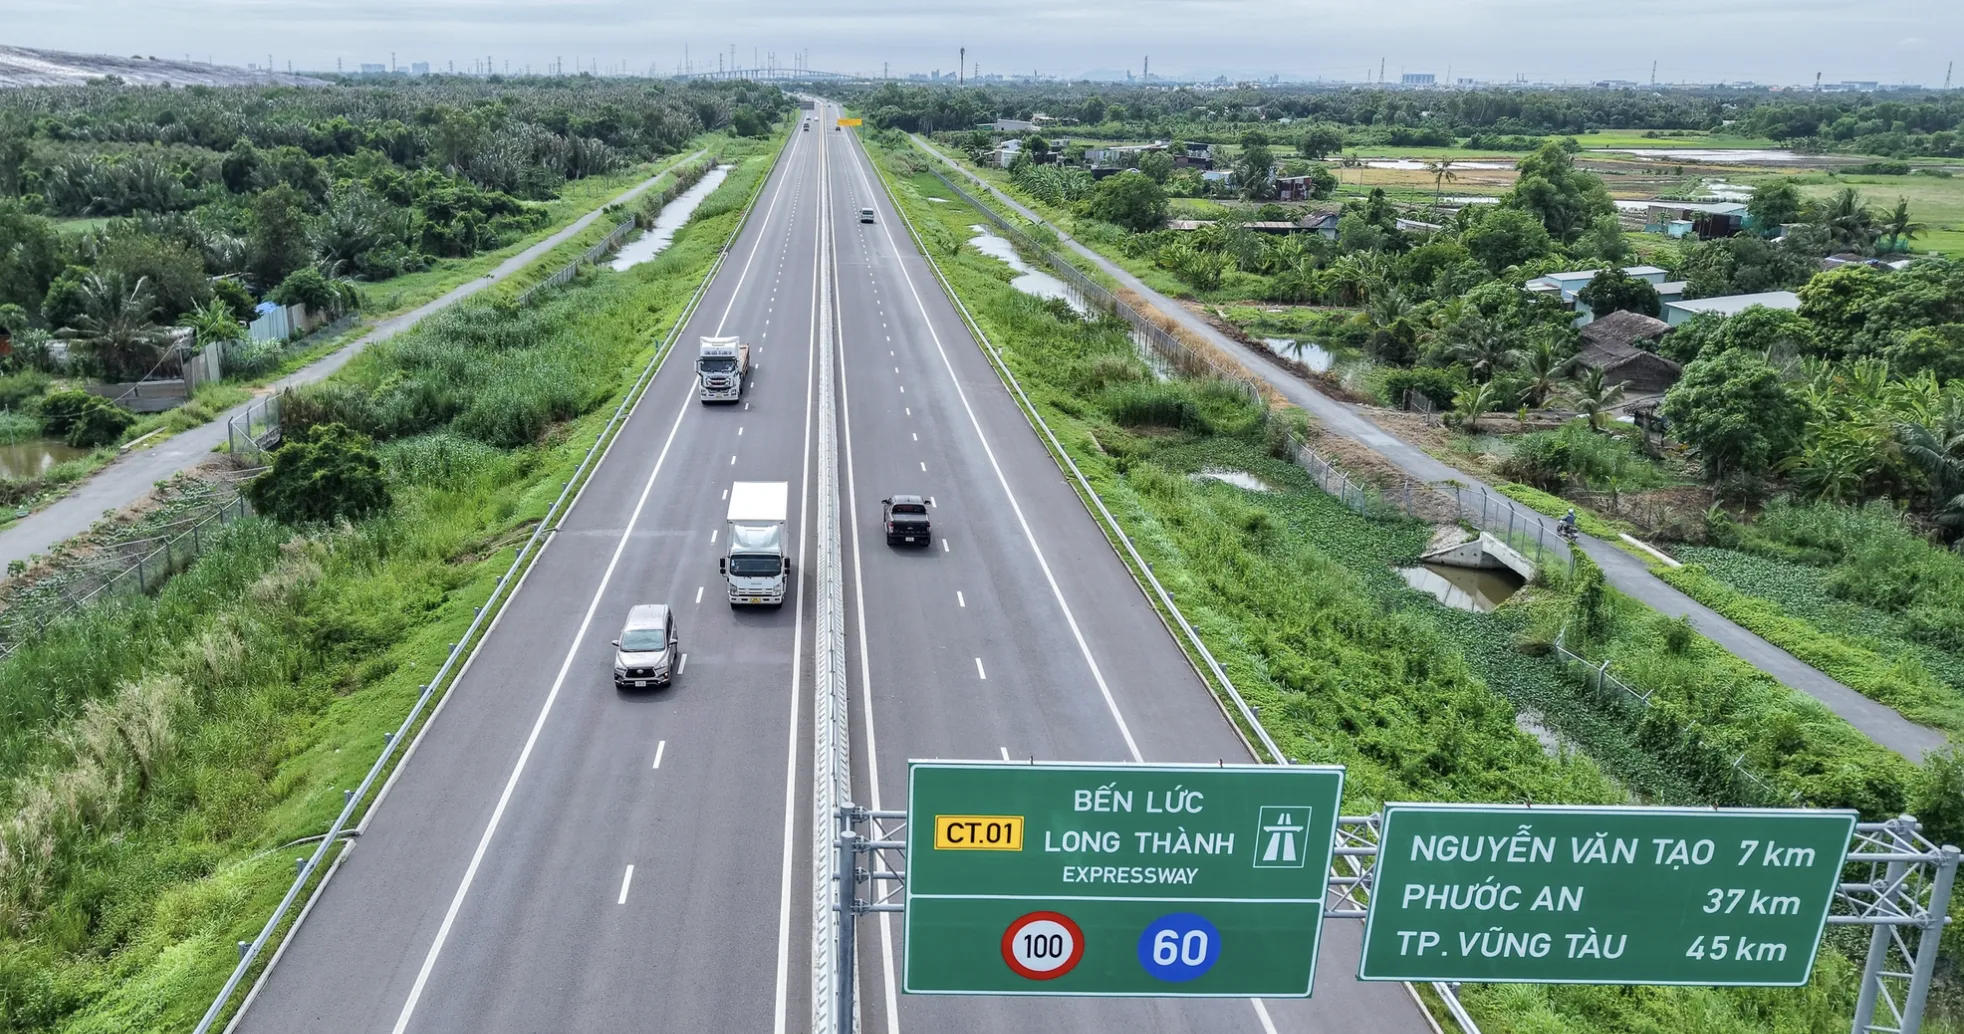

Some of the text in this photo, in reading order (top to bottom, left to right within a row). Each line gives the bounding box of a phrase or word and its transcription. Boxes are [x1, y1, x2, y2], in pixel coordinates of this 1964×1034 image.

[1074, 782, 1204, 814] BẾN LỨC
[946, 822, 1013, 845] CT.01
[1044, 826, 1235, 855] LONG THÀNH
[1410, 824, 1816, 871] NGUYỄN VĂN TẠO 7 km
[1062, 866, 1199, 885] EXPRESSWAY
[1401, 875, 1801, 915] PHƯỚC AN 37 km
[1023, 933, 1063, 959] 100
[1152, 929, 1208, 967] 60
[1396, 926, 1788, 962] TP. VŨNG TÀU 45 km
